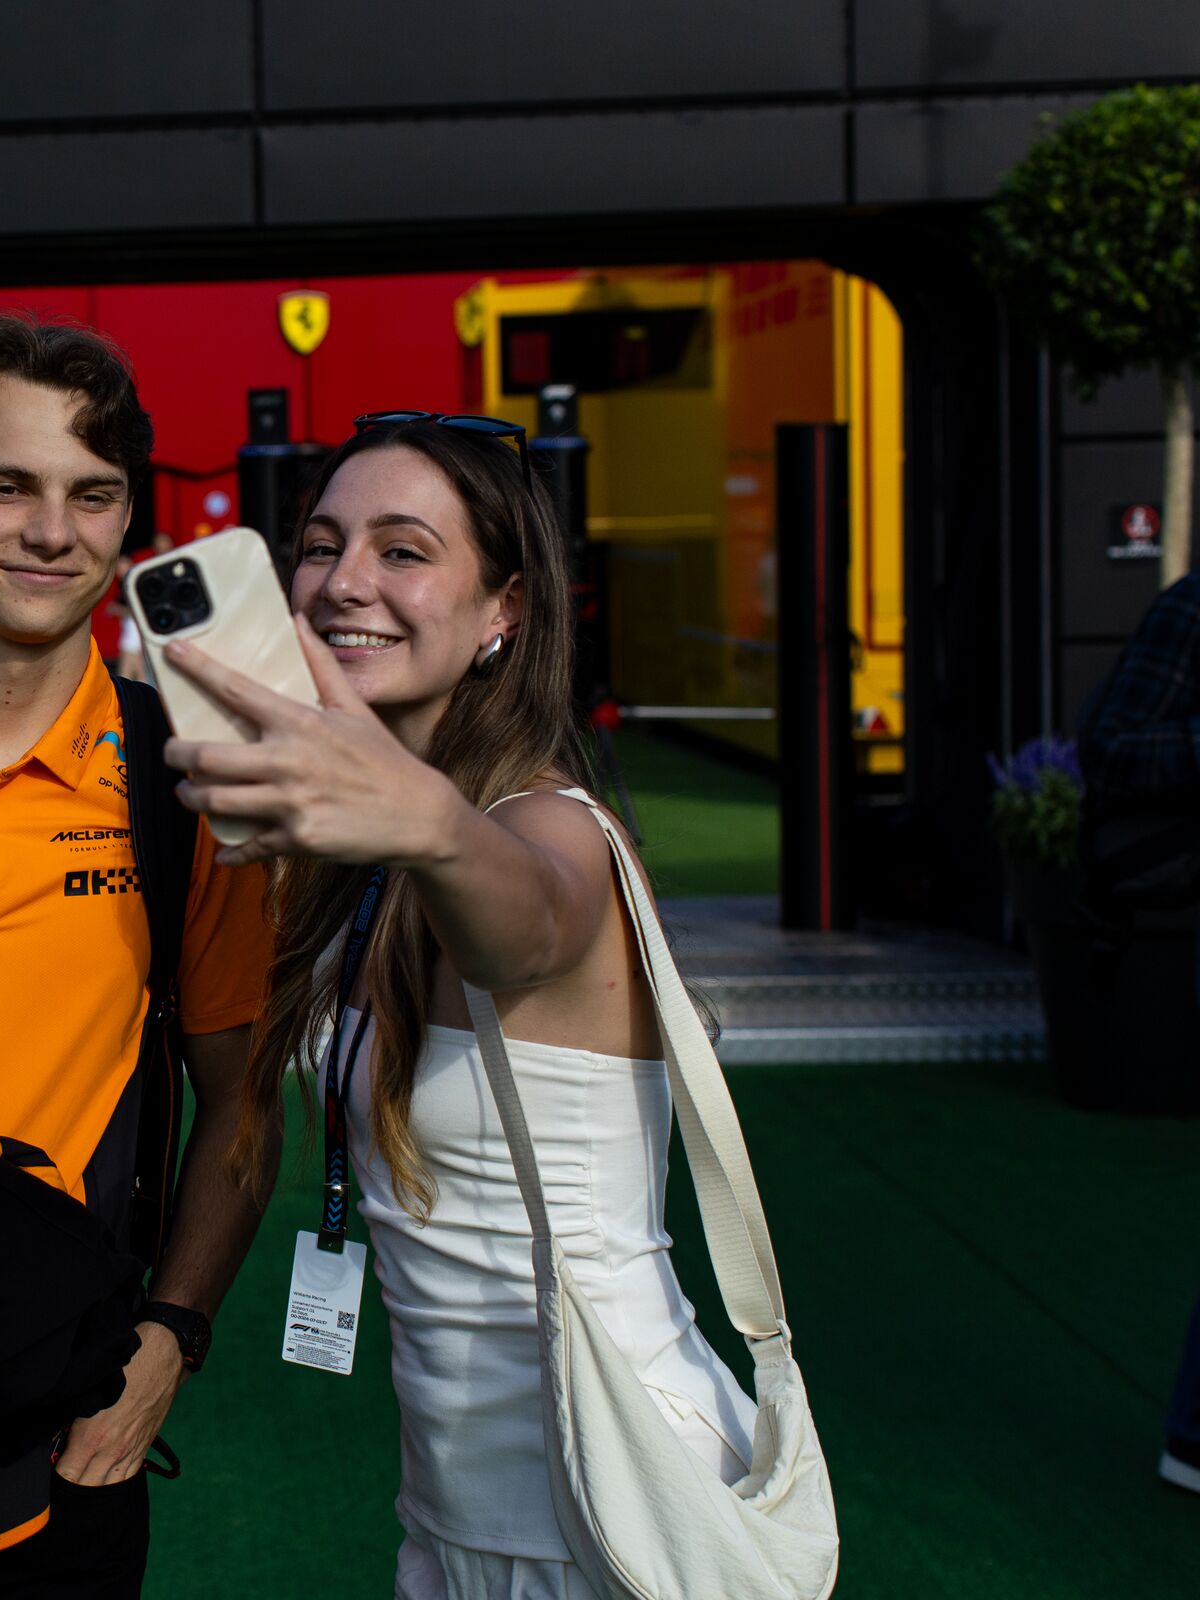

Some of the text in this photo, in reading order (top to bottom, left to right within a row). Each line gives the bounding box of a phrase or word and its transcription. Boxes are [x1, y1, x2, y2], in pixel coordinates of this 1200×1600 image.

[98, 777, 113, 788] DP
[70, 845, 107, 853] FORMULA
[64, 868, 141, 896] OKX
[355, 886, 377, 932] 2024
